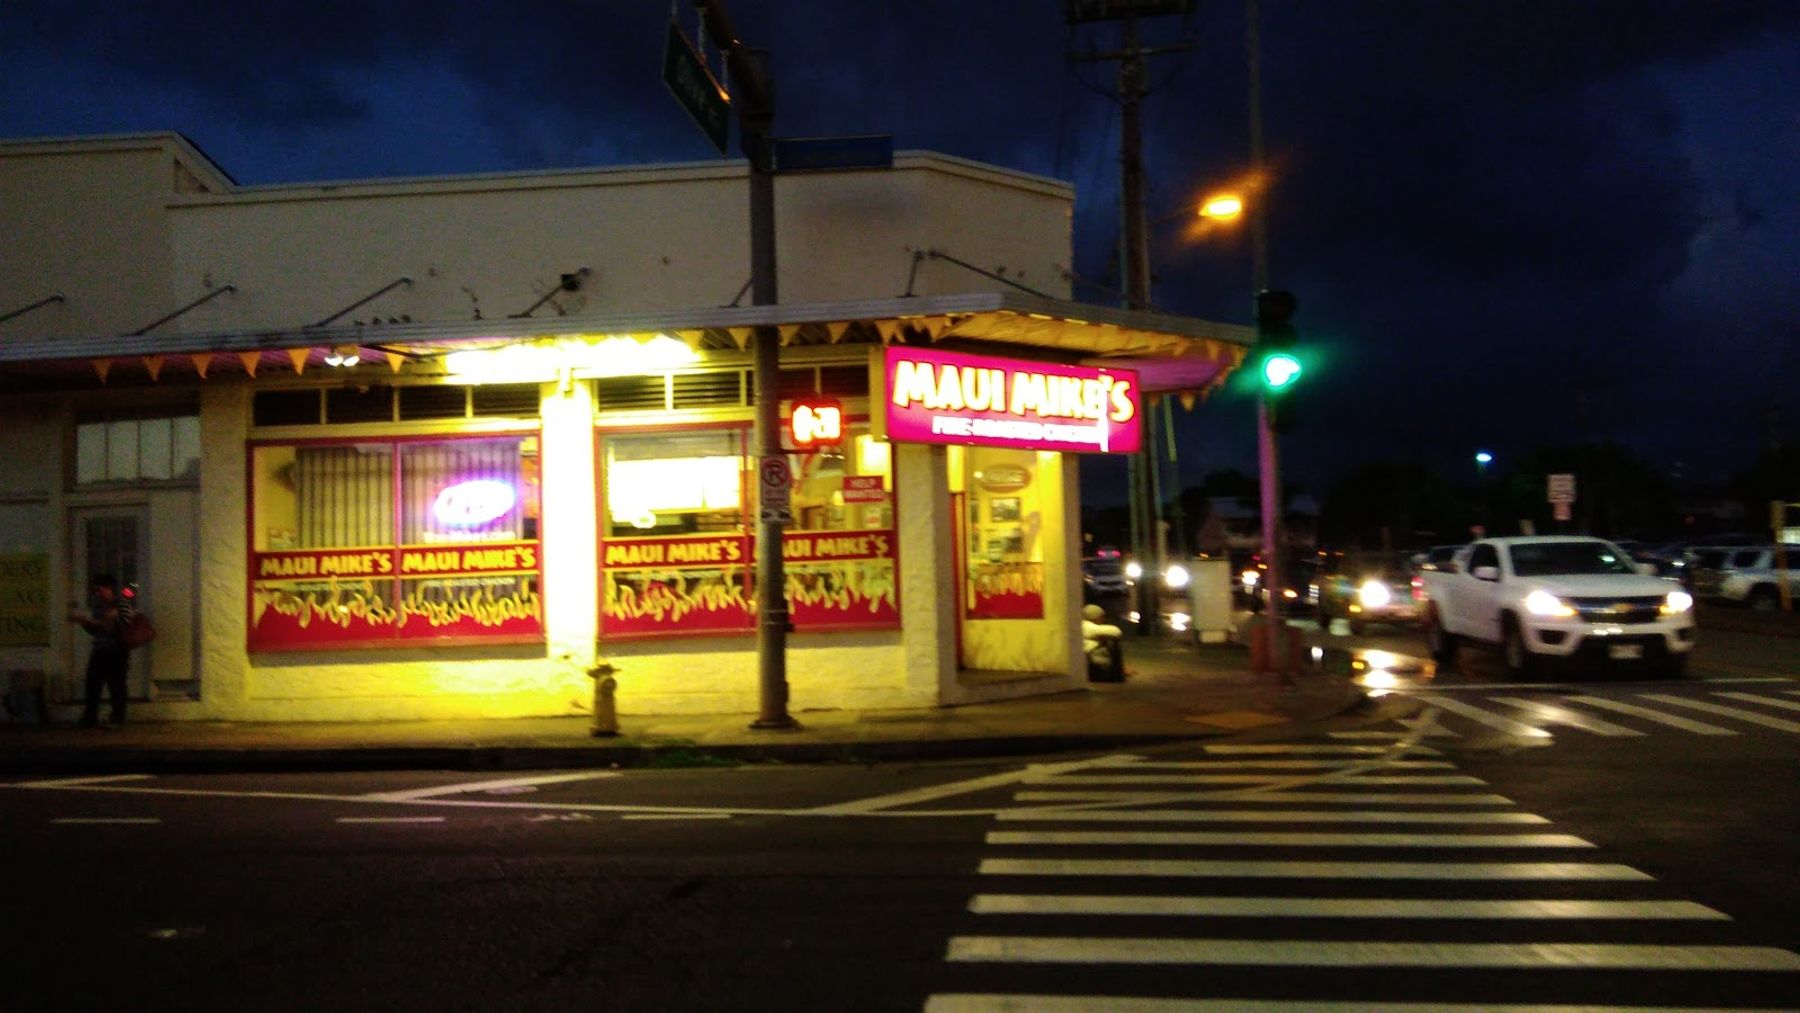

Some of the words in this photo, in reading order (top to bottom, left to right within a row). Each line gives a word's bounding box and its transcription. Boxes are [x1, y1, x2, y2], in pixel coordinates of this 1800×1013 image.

[893, 360, 1007, 412] MAUI
[1010, 370, 1135, 423] MIKE'S
[605, 544, 664, 565] MAUI
[666, 540, 741, 563] MIKE'S
[815, 534, 889, 557] MIKE'S
[261, 556, 317, 576] MAUI
[319, 552, 393, 574] MIKE'S
[402, 551, 460, 572] MAUI
[462, 546, 536, 570] MIKE'S
